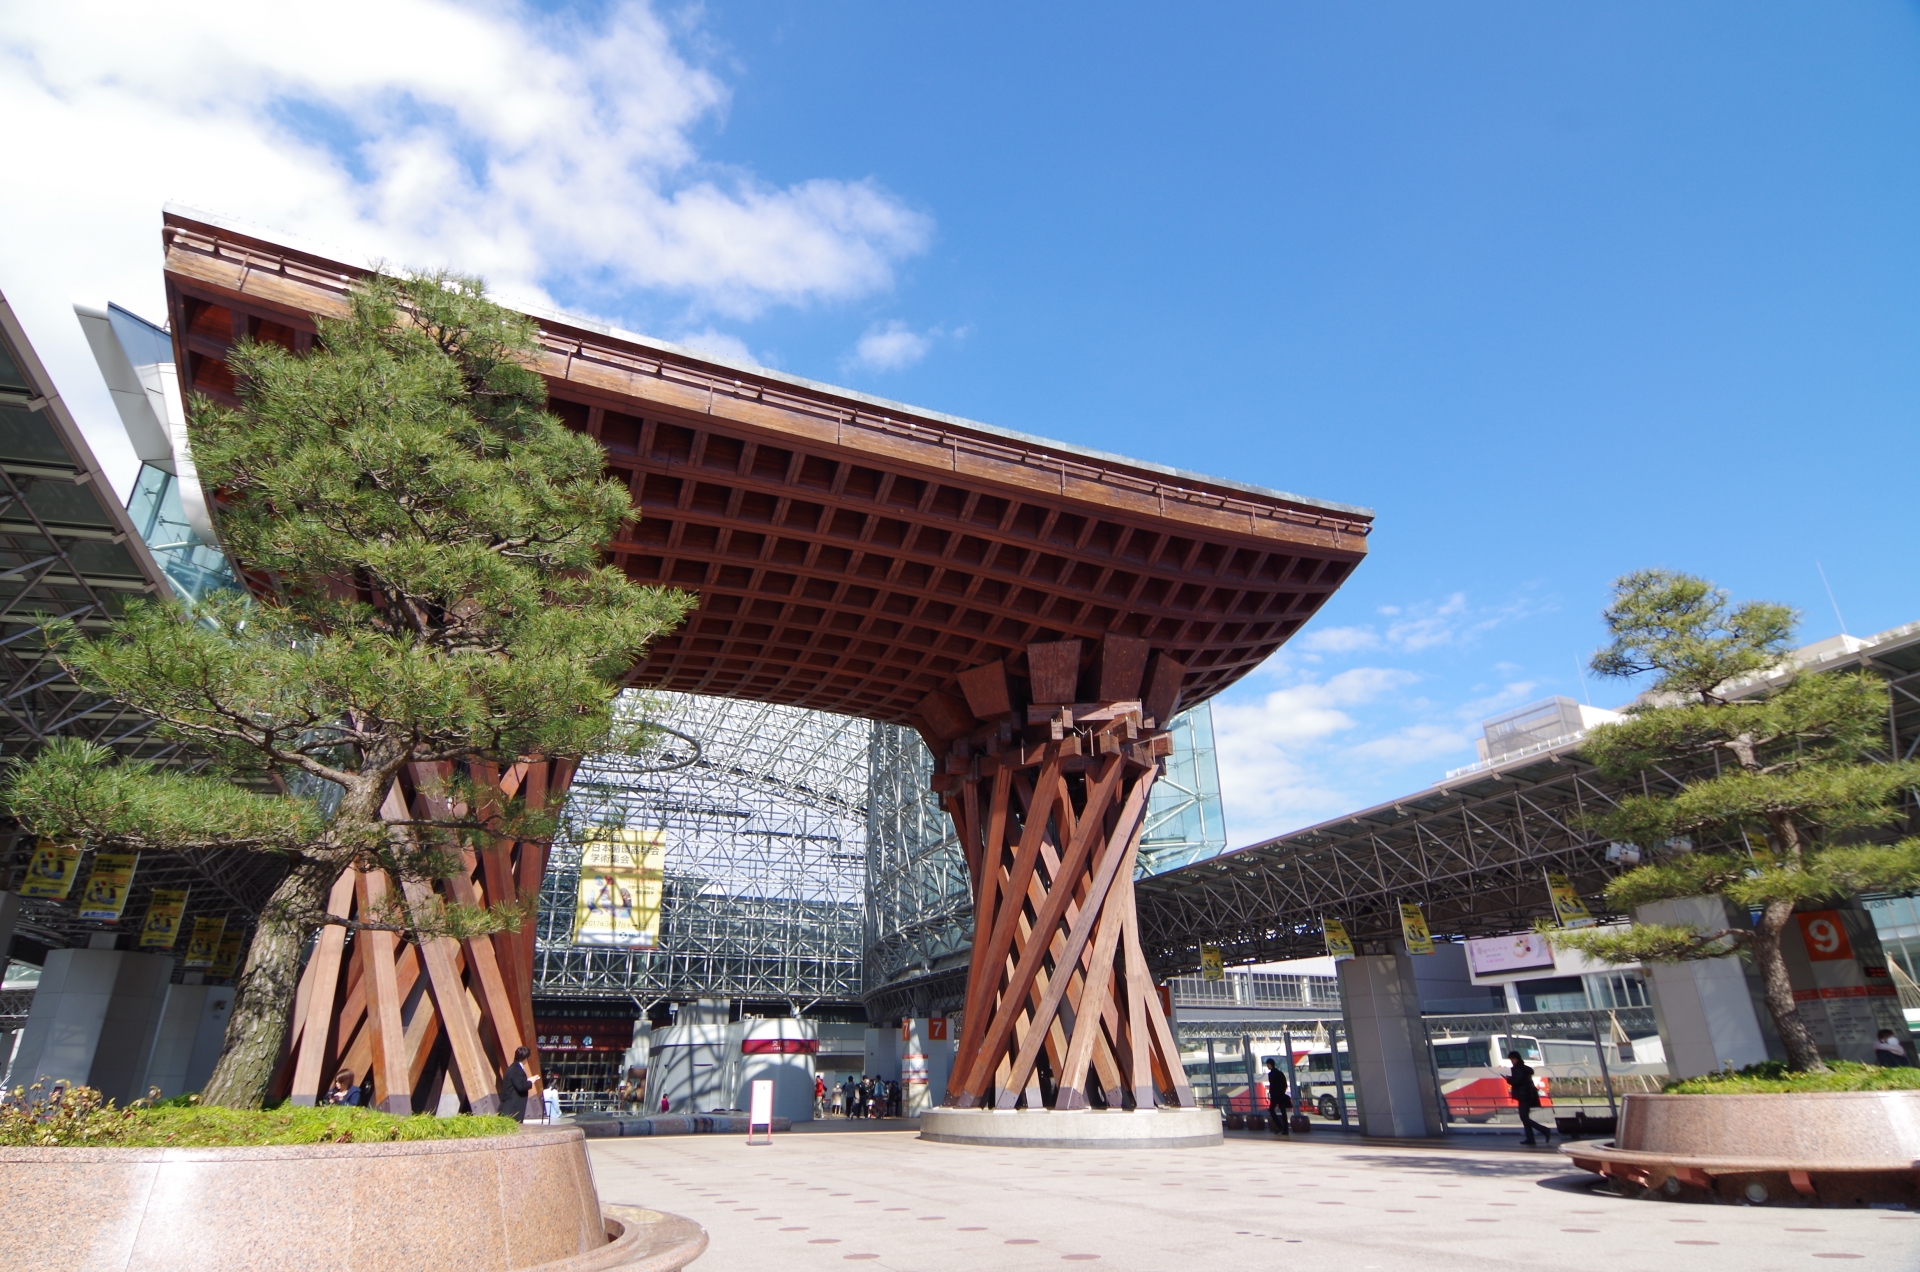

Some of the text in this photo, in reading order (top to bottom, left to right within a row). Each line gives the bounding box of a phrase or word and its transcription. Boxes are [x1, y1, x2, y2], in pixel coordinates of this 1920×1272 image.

[1808, 919, 1840, 953] 9
[932, 1021, 943, 1037] 7
[537, 1035, 572, 1044] 金沢駅
